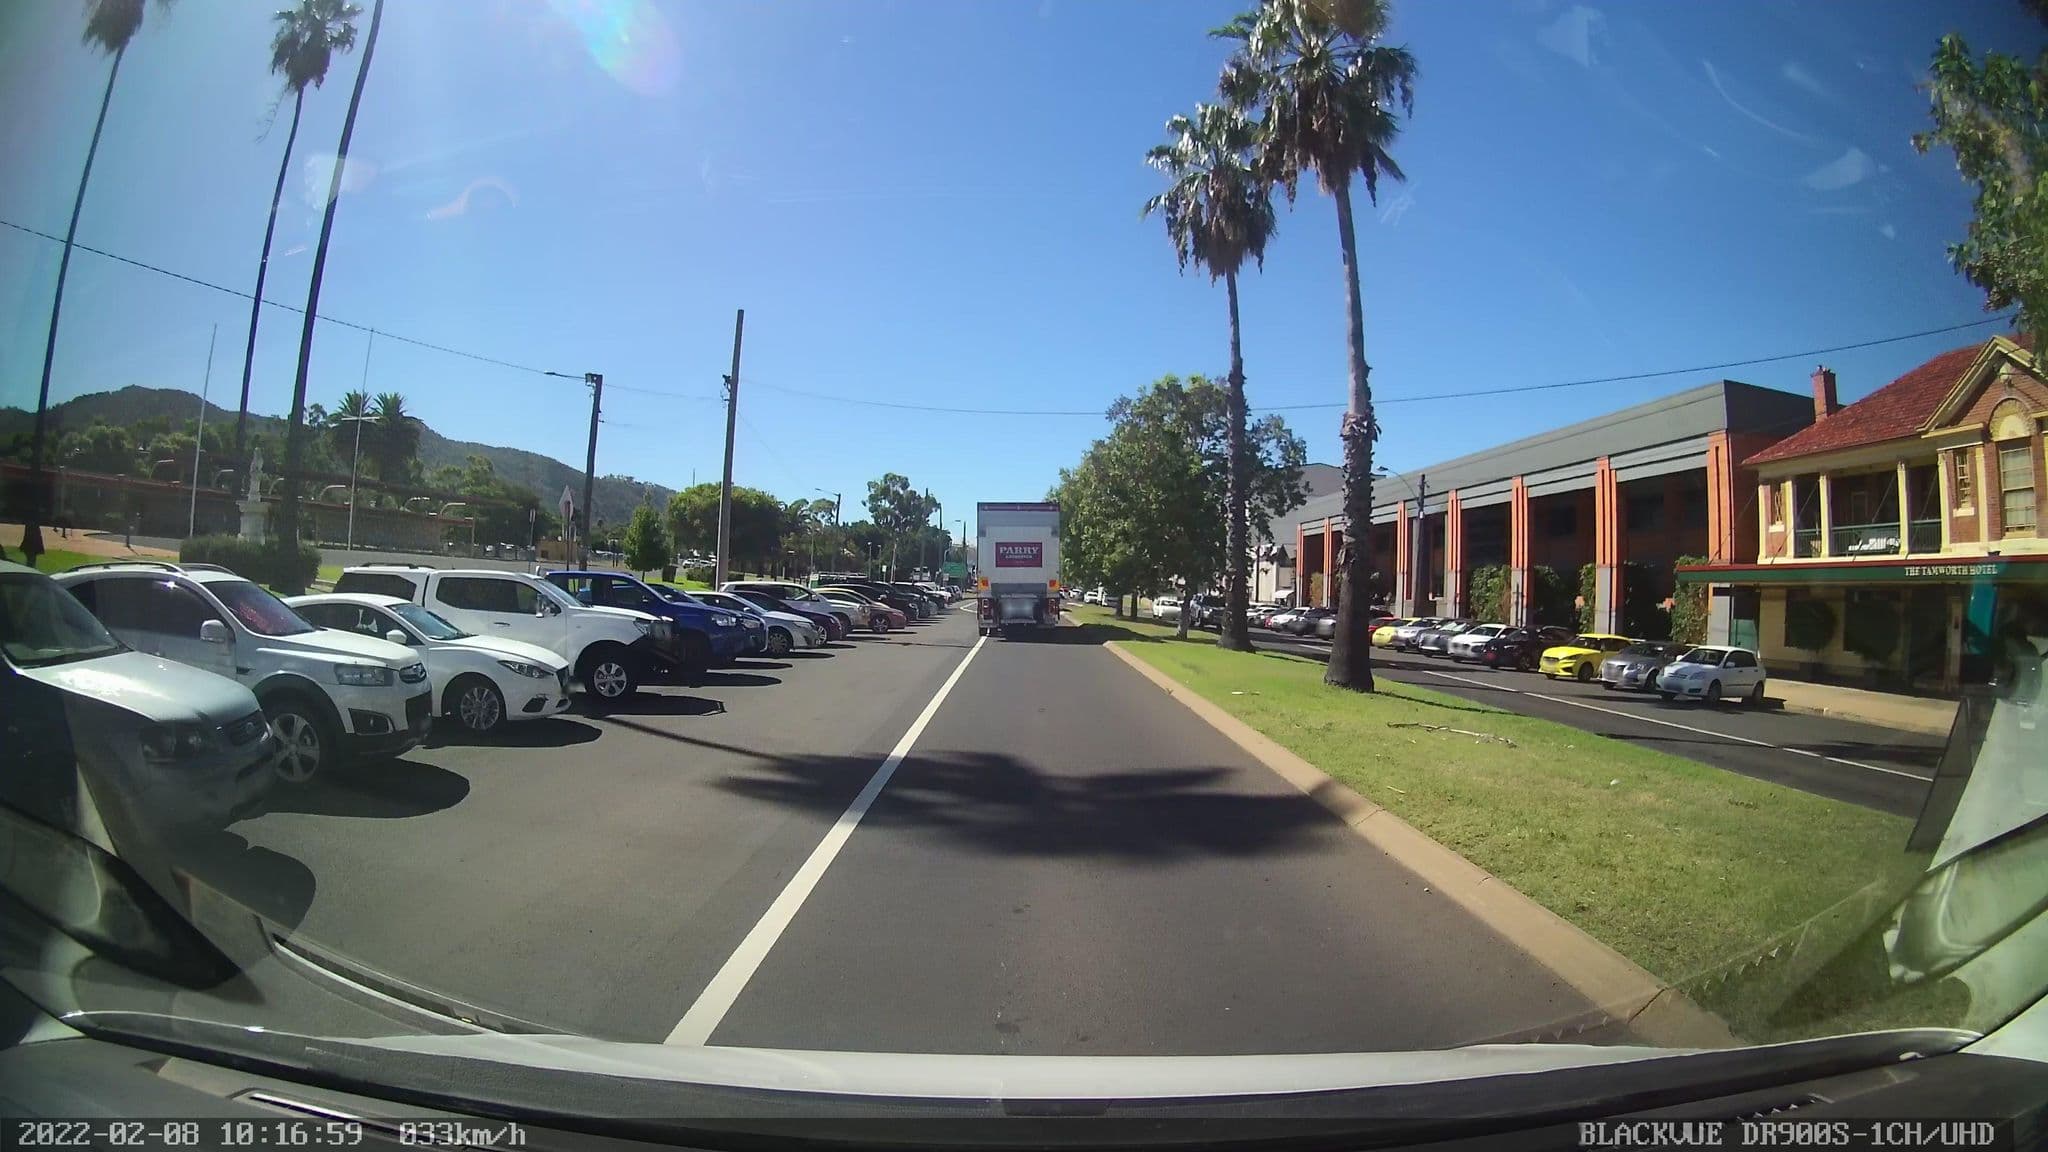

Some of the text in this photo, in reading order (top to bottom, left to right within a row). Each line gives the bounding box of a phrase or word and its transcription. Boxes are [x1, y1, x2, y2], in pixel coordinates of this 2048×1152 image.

[999, 546, 1039, 554] PARRY
[1904, 564, 1998, 576] THE TAMWORTH HOTEL
